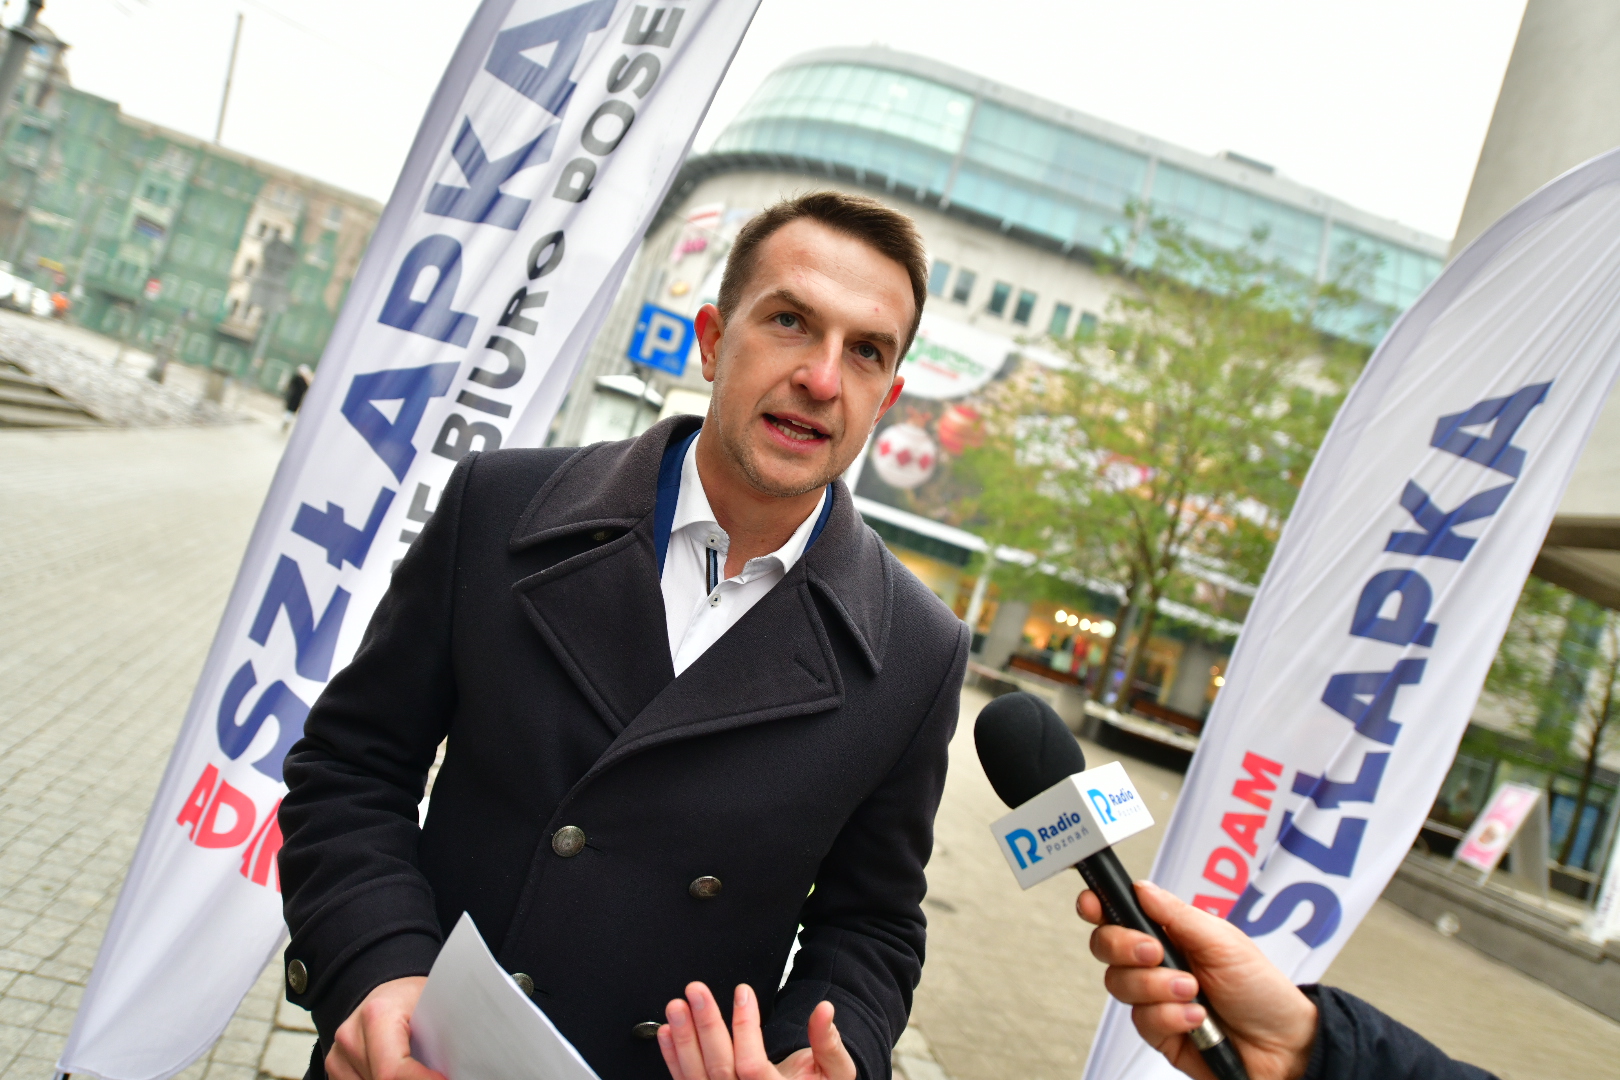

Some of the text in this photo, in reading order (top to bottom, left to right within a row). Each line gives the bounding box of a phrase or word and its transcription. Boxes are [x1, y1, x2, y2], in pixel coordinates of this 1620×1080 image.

[432, 229, 565, 462] BIURO
[640, 312, 686, 360] P
[217, 0, 618, 783] SZŁAPKA
[1109, 787, 1134, 807] Radio
[1038, 811, 1081, 842] Radio
[1046, 825, 1090, 855] Poznań
